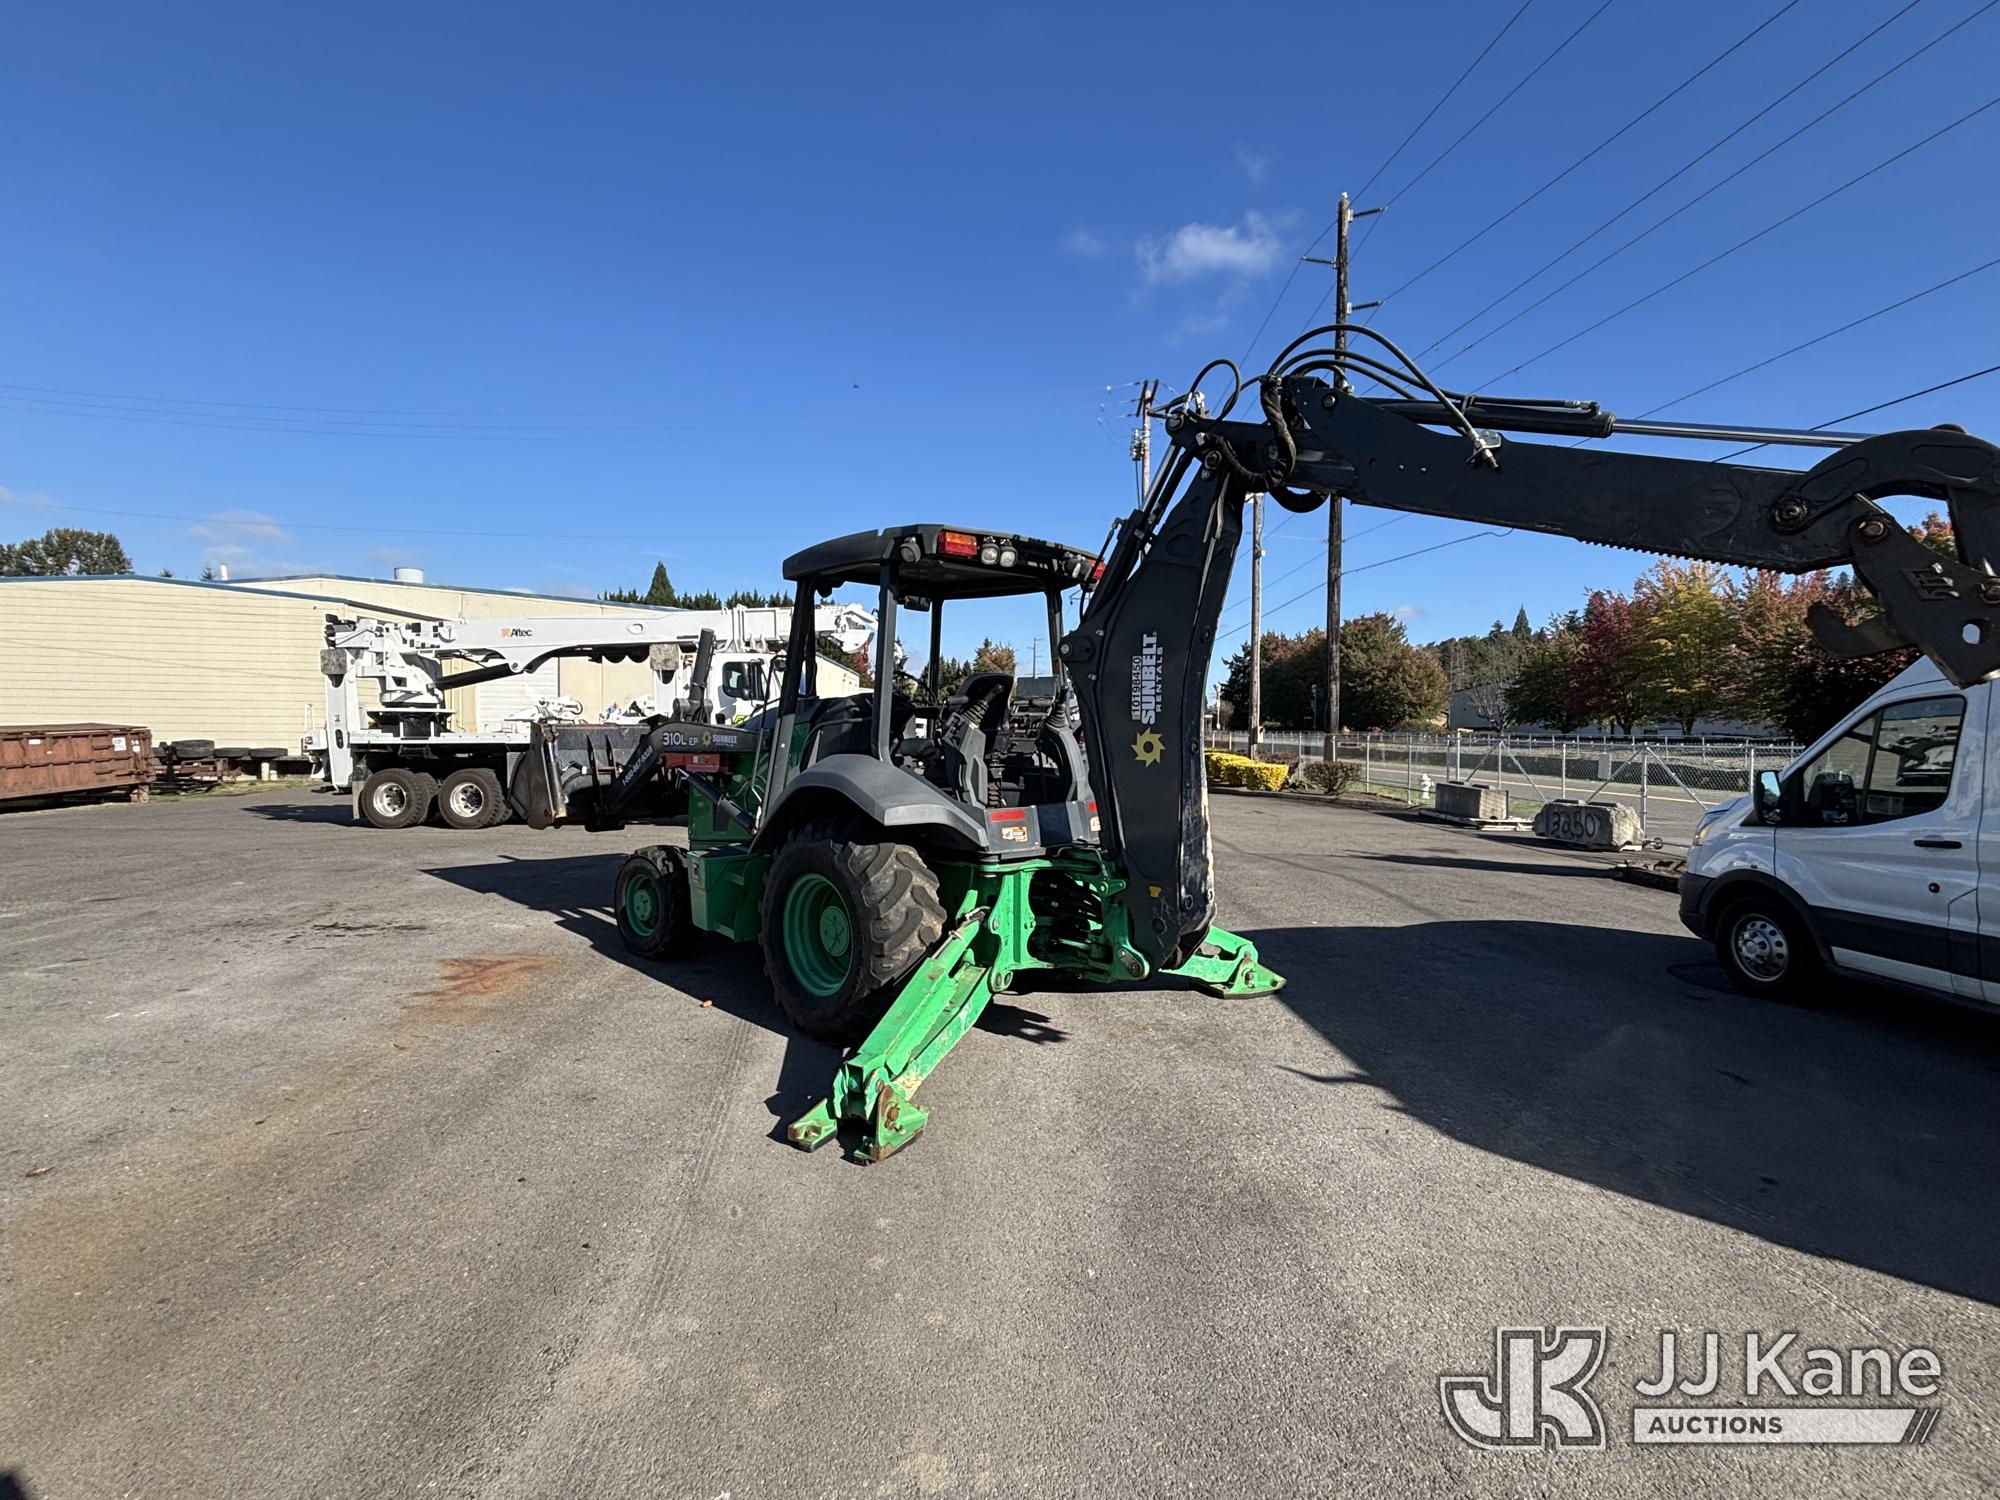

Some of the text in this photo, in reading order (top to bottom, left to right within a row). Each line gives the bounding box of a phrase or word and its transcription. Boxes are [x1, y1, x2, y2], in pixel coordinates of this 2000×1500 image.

[511, 628, 533, 637] Altec
[1131, 656, 1141, 715] 10198450
[1142, 634, 1157, 725] SUNBELT
[1155, 647, 1163, 712] RENTALS
[662, 732, 699, 746] 310L EP
